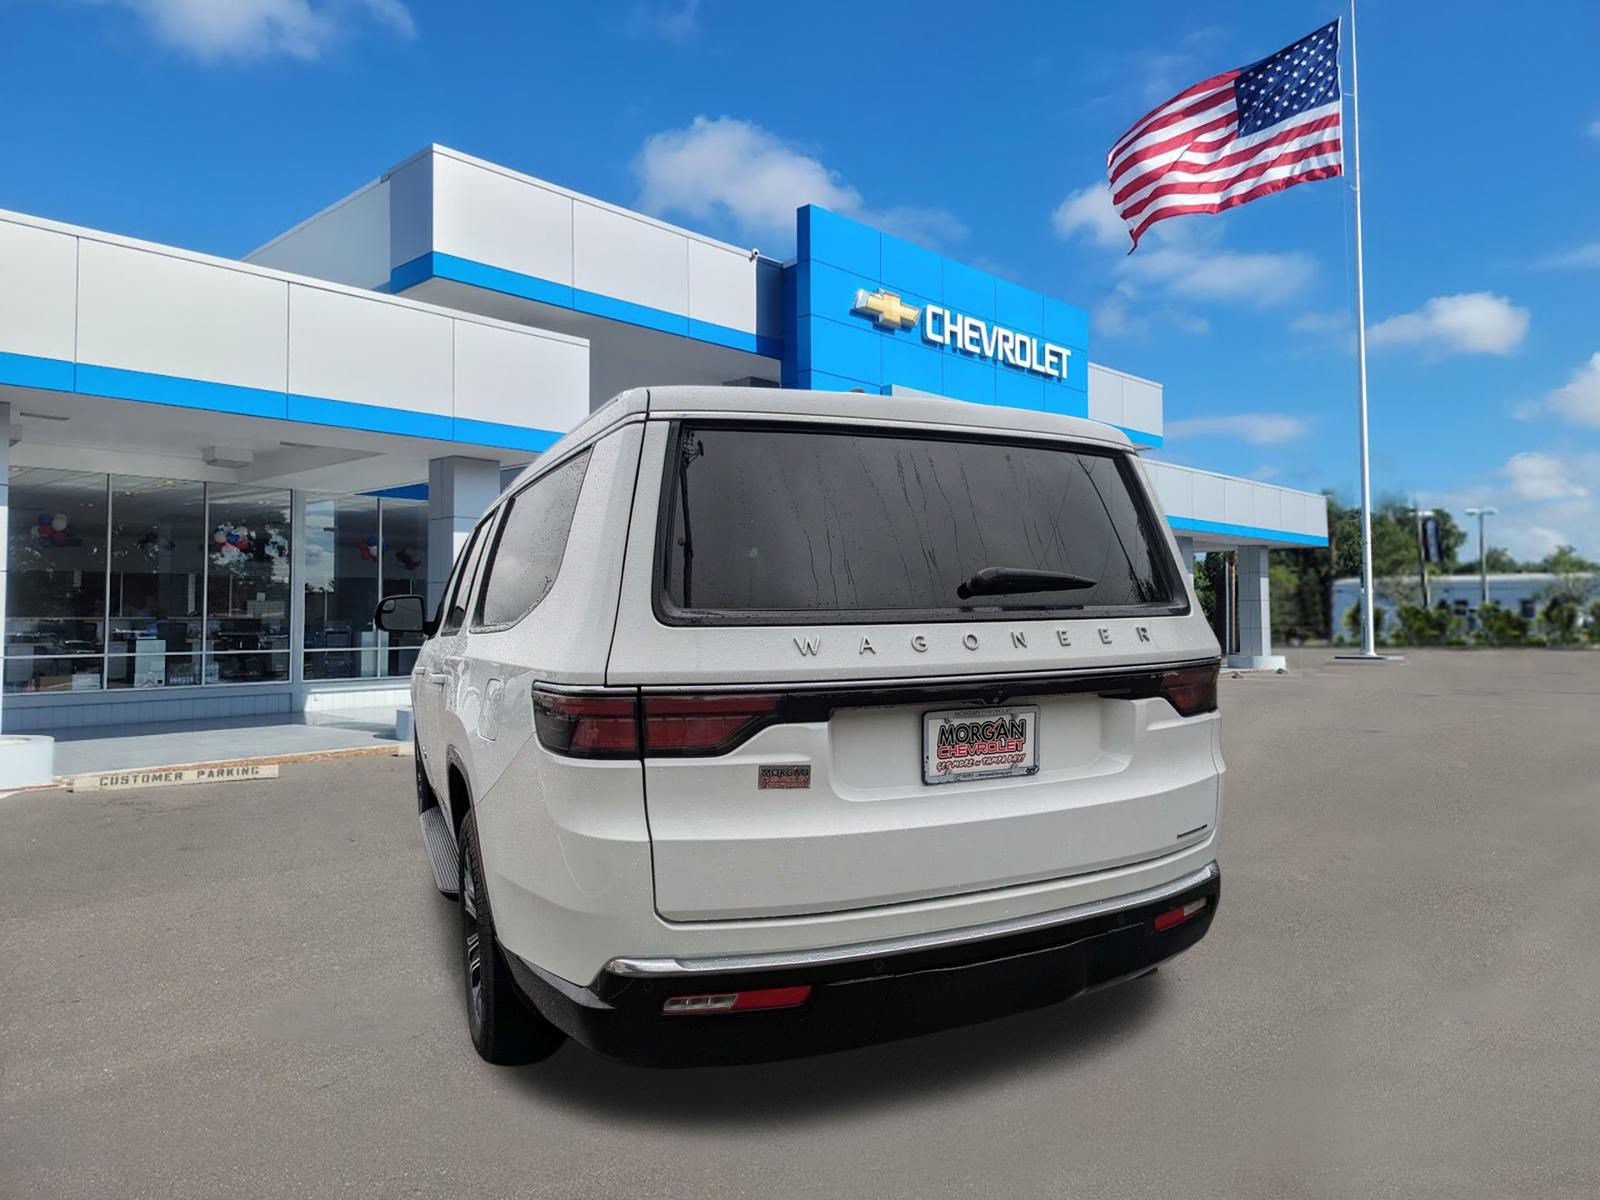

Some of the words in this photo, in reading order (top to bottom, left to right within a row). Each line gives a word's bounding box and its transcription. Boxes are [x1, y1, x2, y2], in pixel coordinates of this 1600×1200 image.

[925, 303, 1072, 379] CHEVROLET
[793, 626, 1151, 656] WAGONEER
[938, 717, 1026, 747] MORGAN
[937, 738, 1025, 759] CHEVROLET
[100, 772, 184, 786] CUSTOMER
[197, 766, 260, 779] PARKING
[762, 767, 809, 777] MORGAN
